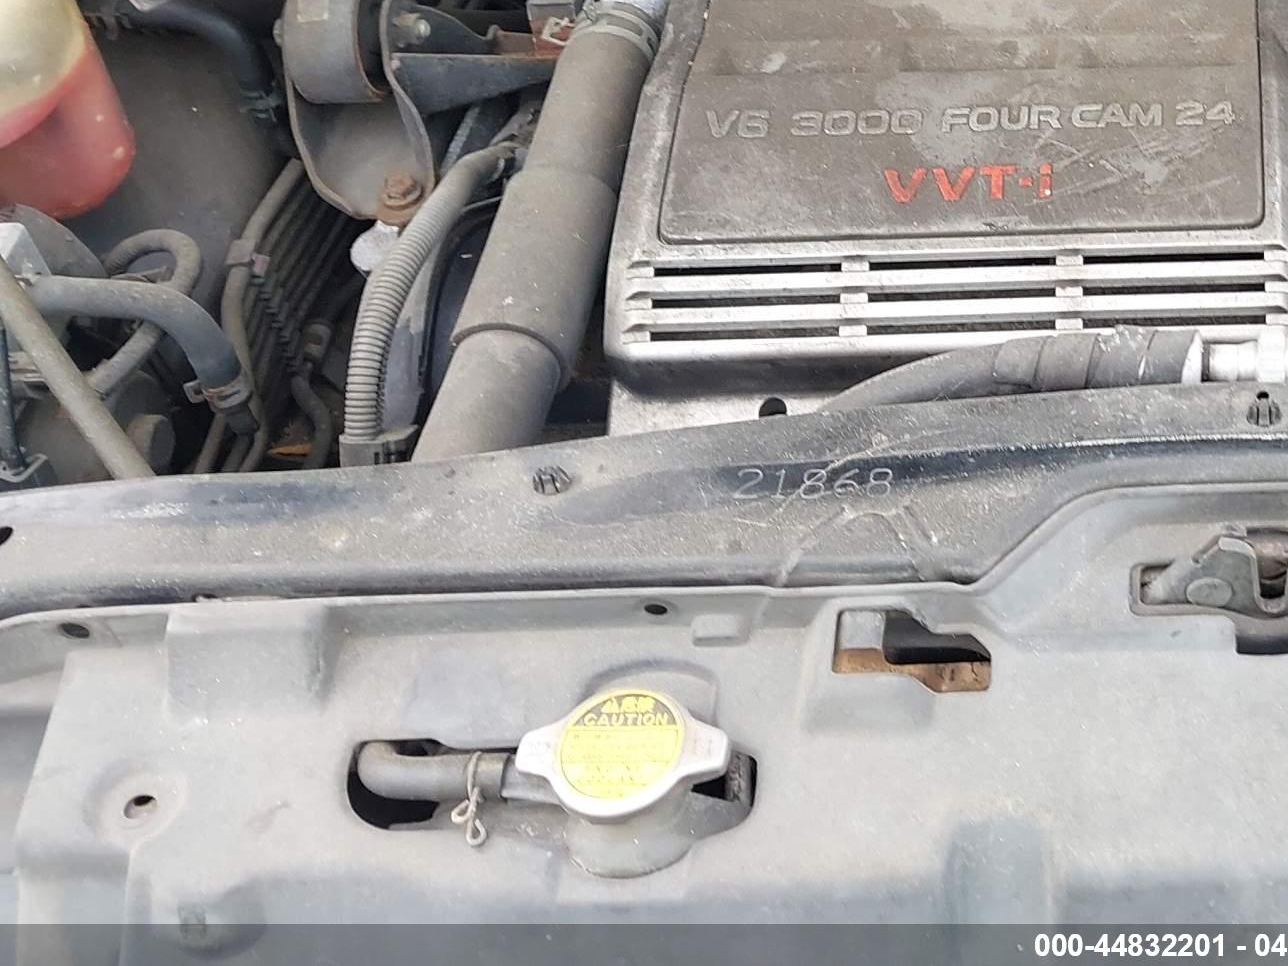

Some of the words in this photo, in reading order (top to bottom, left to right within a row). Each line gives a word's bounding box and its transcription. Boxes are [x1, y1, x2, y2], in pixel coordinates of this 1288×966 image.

[706, 109, 770, 138] V6
[790, 109, 924, 136] 3000
[942, 105, 1062, 132] FOUR
[1071, 103, 1162, 128] CAM
[1175, 100, 1236, 125] 24
[884, 162, 1054, 202] VVT-i
[733, 468, 893, 500] 21868
[582, 711, 669, 727] CAUTION
